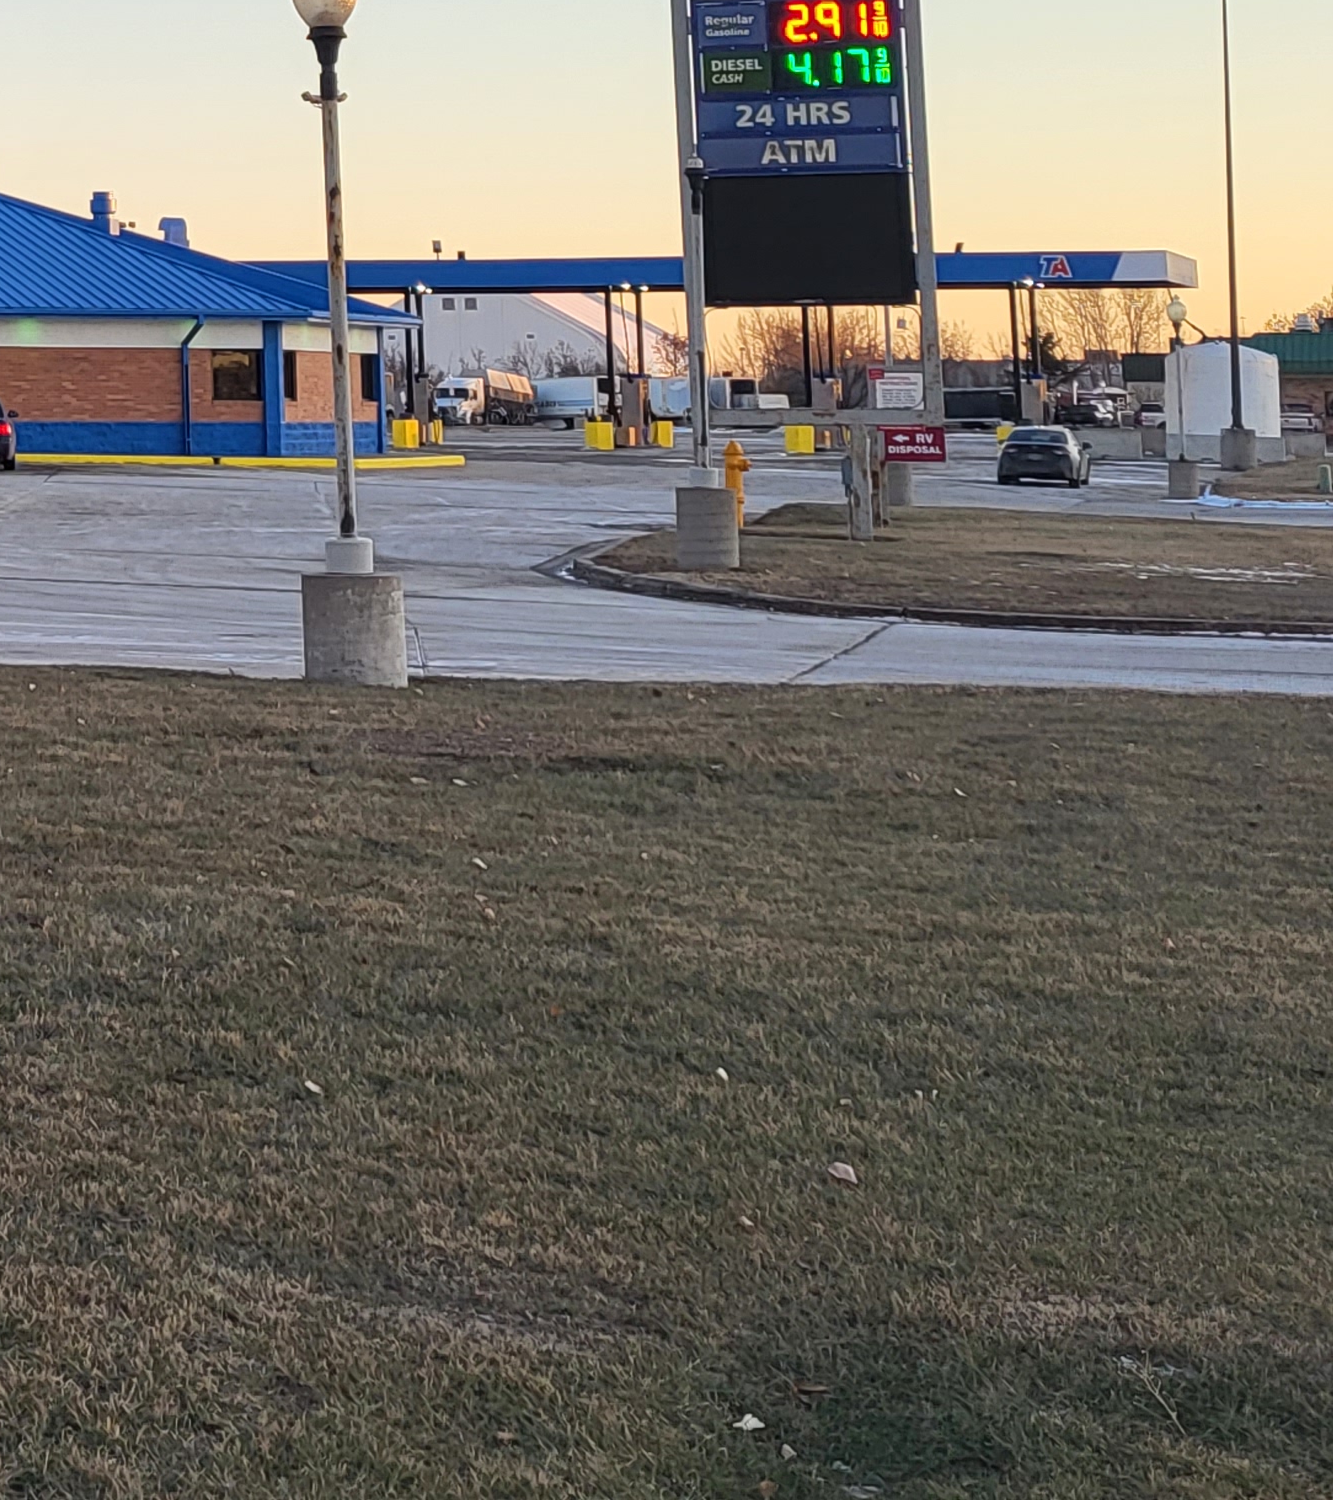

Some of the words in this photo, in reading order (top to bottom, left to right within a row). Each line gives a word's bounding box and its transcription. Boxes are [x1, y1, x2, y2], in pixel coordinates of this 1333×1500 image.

[705, 15, 754, 27] Regular
[706, 28, 750, 37] Gasoline
[711, 59, 763, 71] DIESEL
[712, 74, 743, 84] CASH
[736, 105, 775, 127] 24
[786, 101, 851, 126] HRS
[761, 140, 837, 165] ATM
[1039, 255, 1072, 278] TA
[915, 433, 934, 444] RV
[888, 446, 943, 455] DISPOSAL
